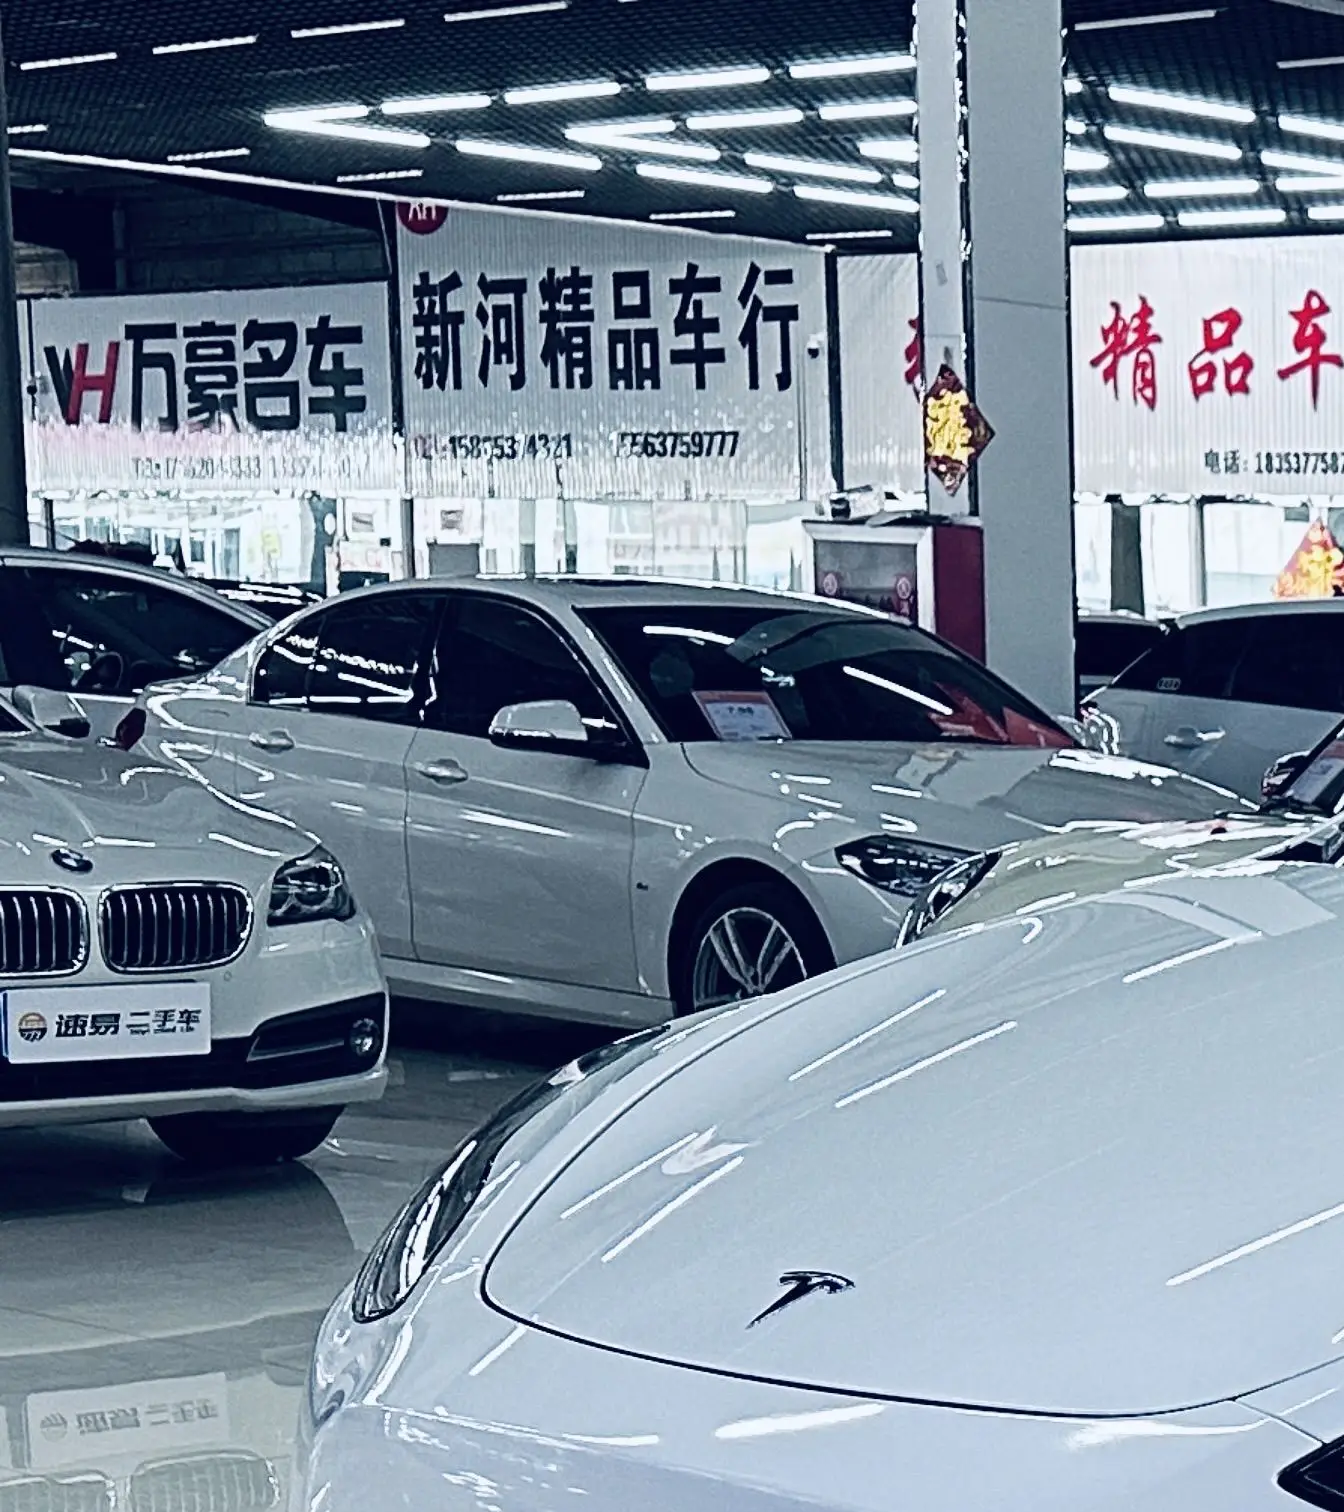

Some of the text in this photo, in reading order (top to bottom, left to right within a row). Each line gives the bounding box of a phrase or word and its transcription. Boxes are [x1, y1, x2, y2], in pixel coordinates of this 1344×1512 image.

[124, 315, 367, 433] 万豪名车
[413, 261, 798, 392] 新河精品车行
